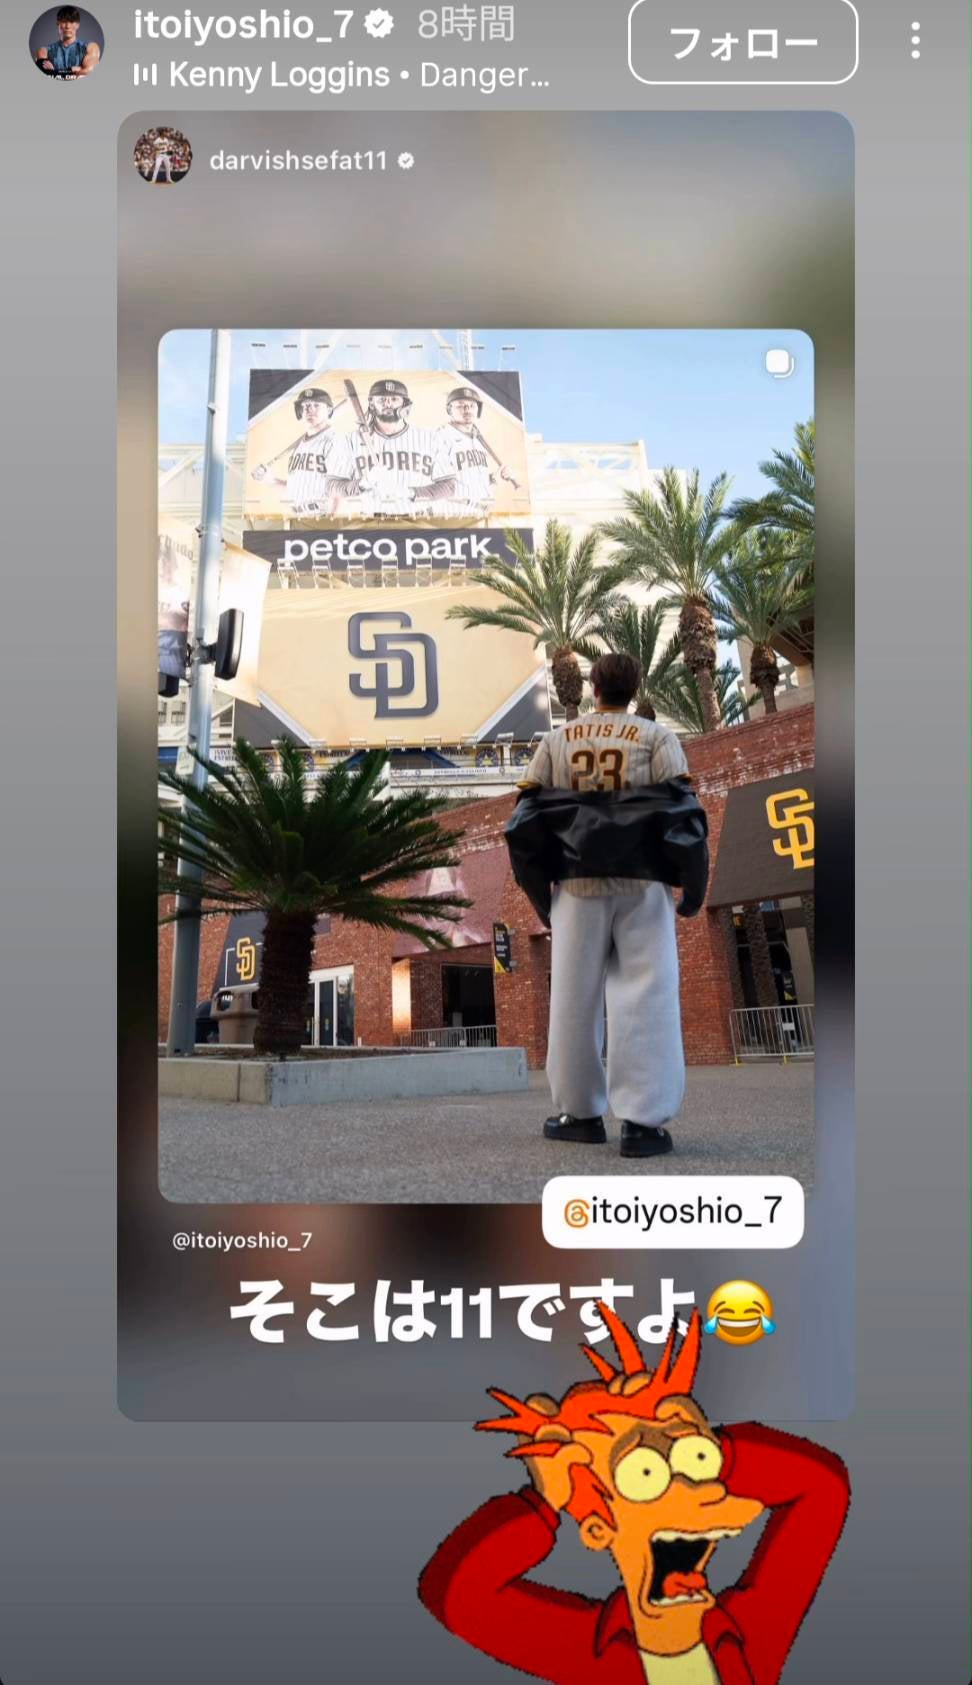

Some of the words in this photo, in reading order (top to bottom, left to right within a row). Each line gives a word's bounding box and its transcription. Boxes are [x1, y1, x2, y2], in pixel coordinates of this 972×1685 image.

[284, 534, 397, 567] petco
[405, 534, 493, 566] park
[348, 611, 439, 719] SD
[565, 723, 614, 742] TATIS
[616, 724, 639, 742] JR.
[571, 748, 624, 793] 23
